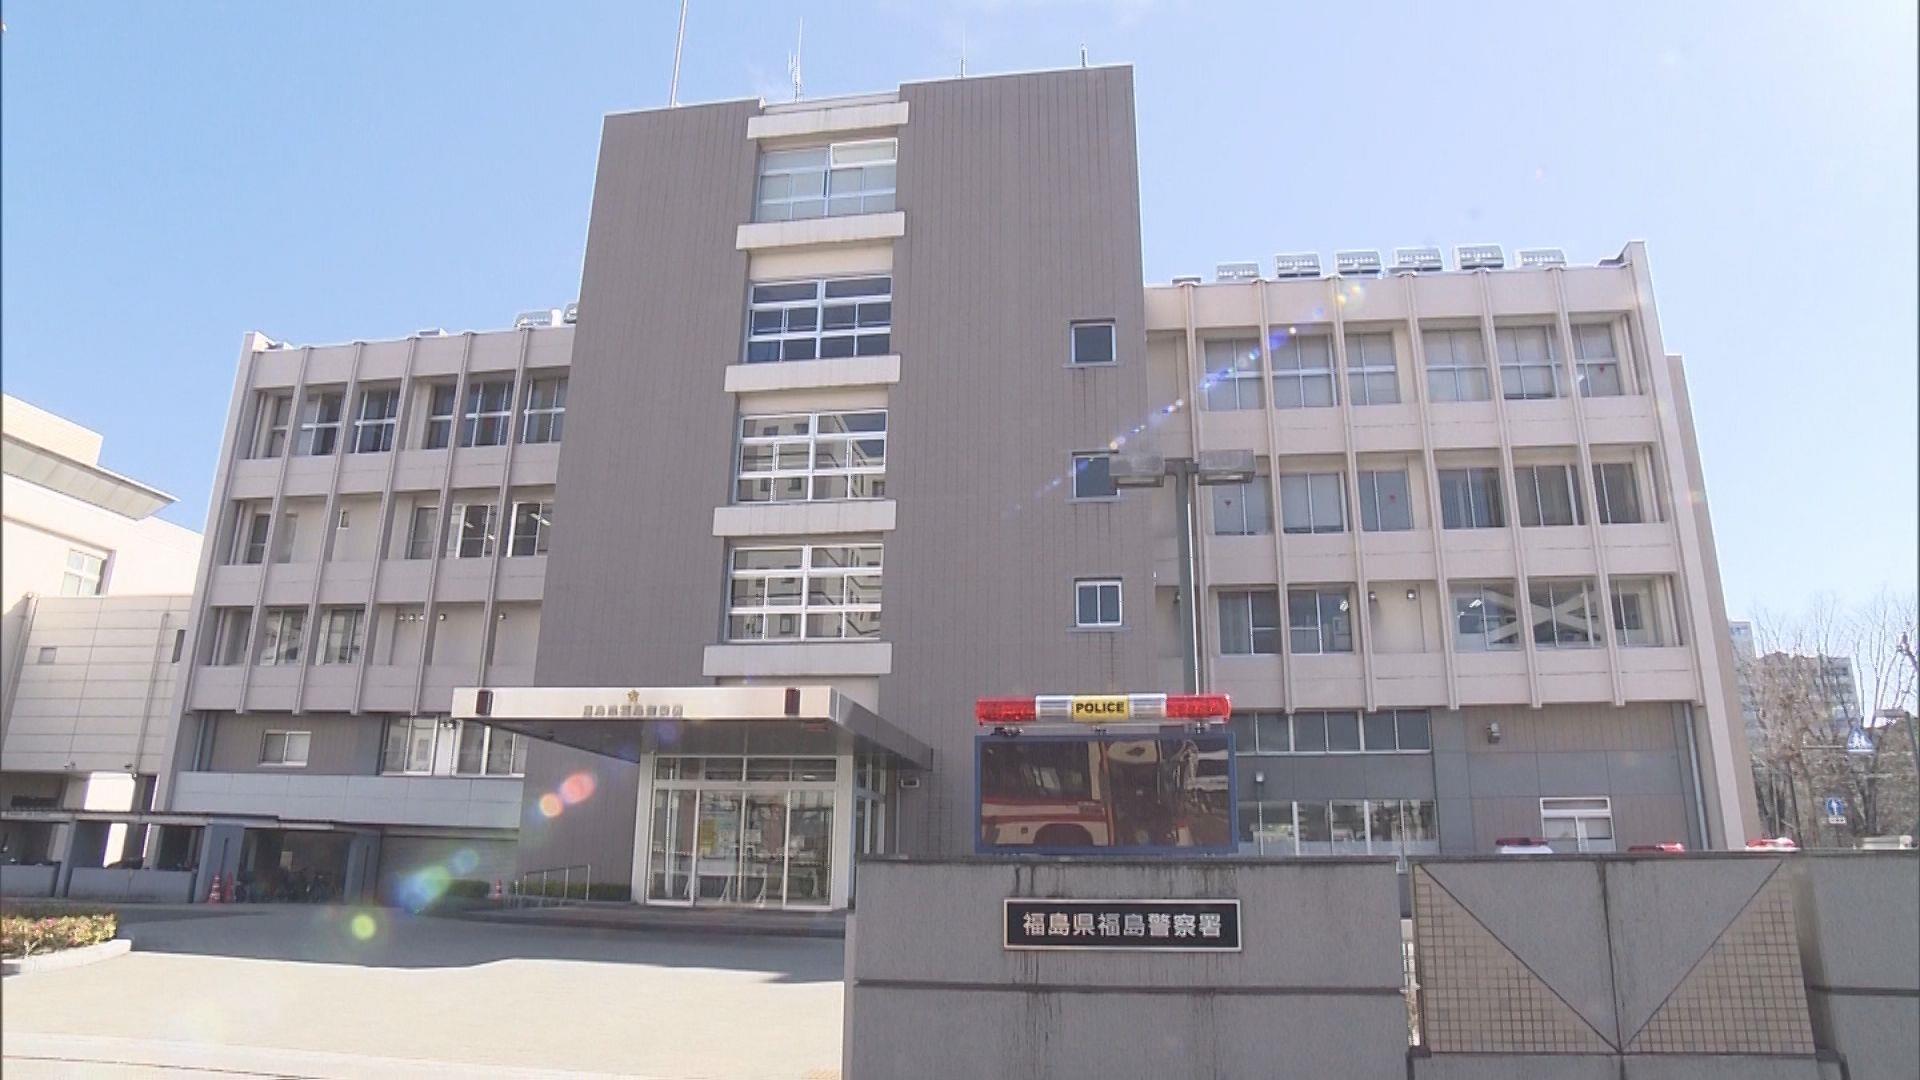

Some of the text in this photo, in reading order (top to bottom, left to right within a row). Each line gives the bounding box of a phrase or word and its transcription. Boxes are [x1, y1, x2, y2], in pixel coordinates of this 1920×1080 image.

[1075, 702, 1125, 714] POLICE
[1023, 911, 1221, 937] 福島県福島警察署
